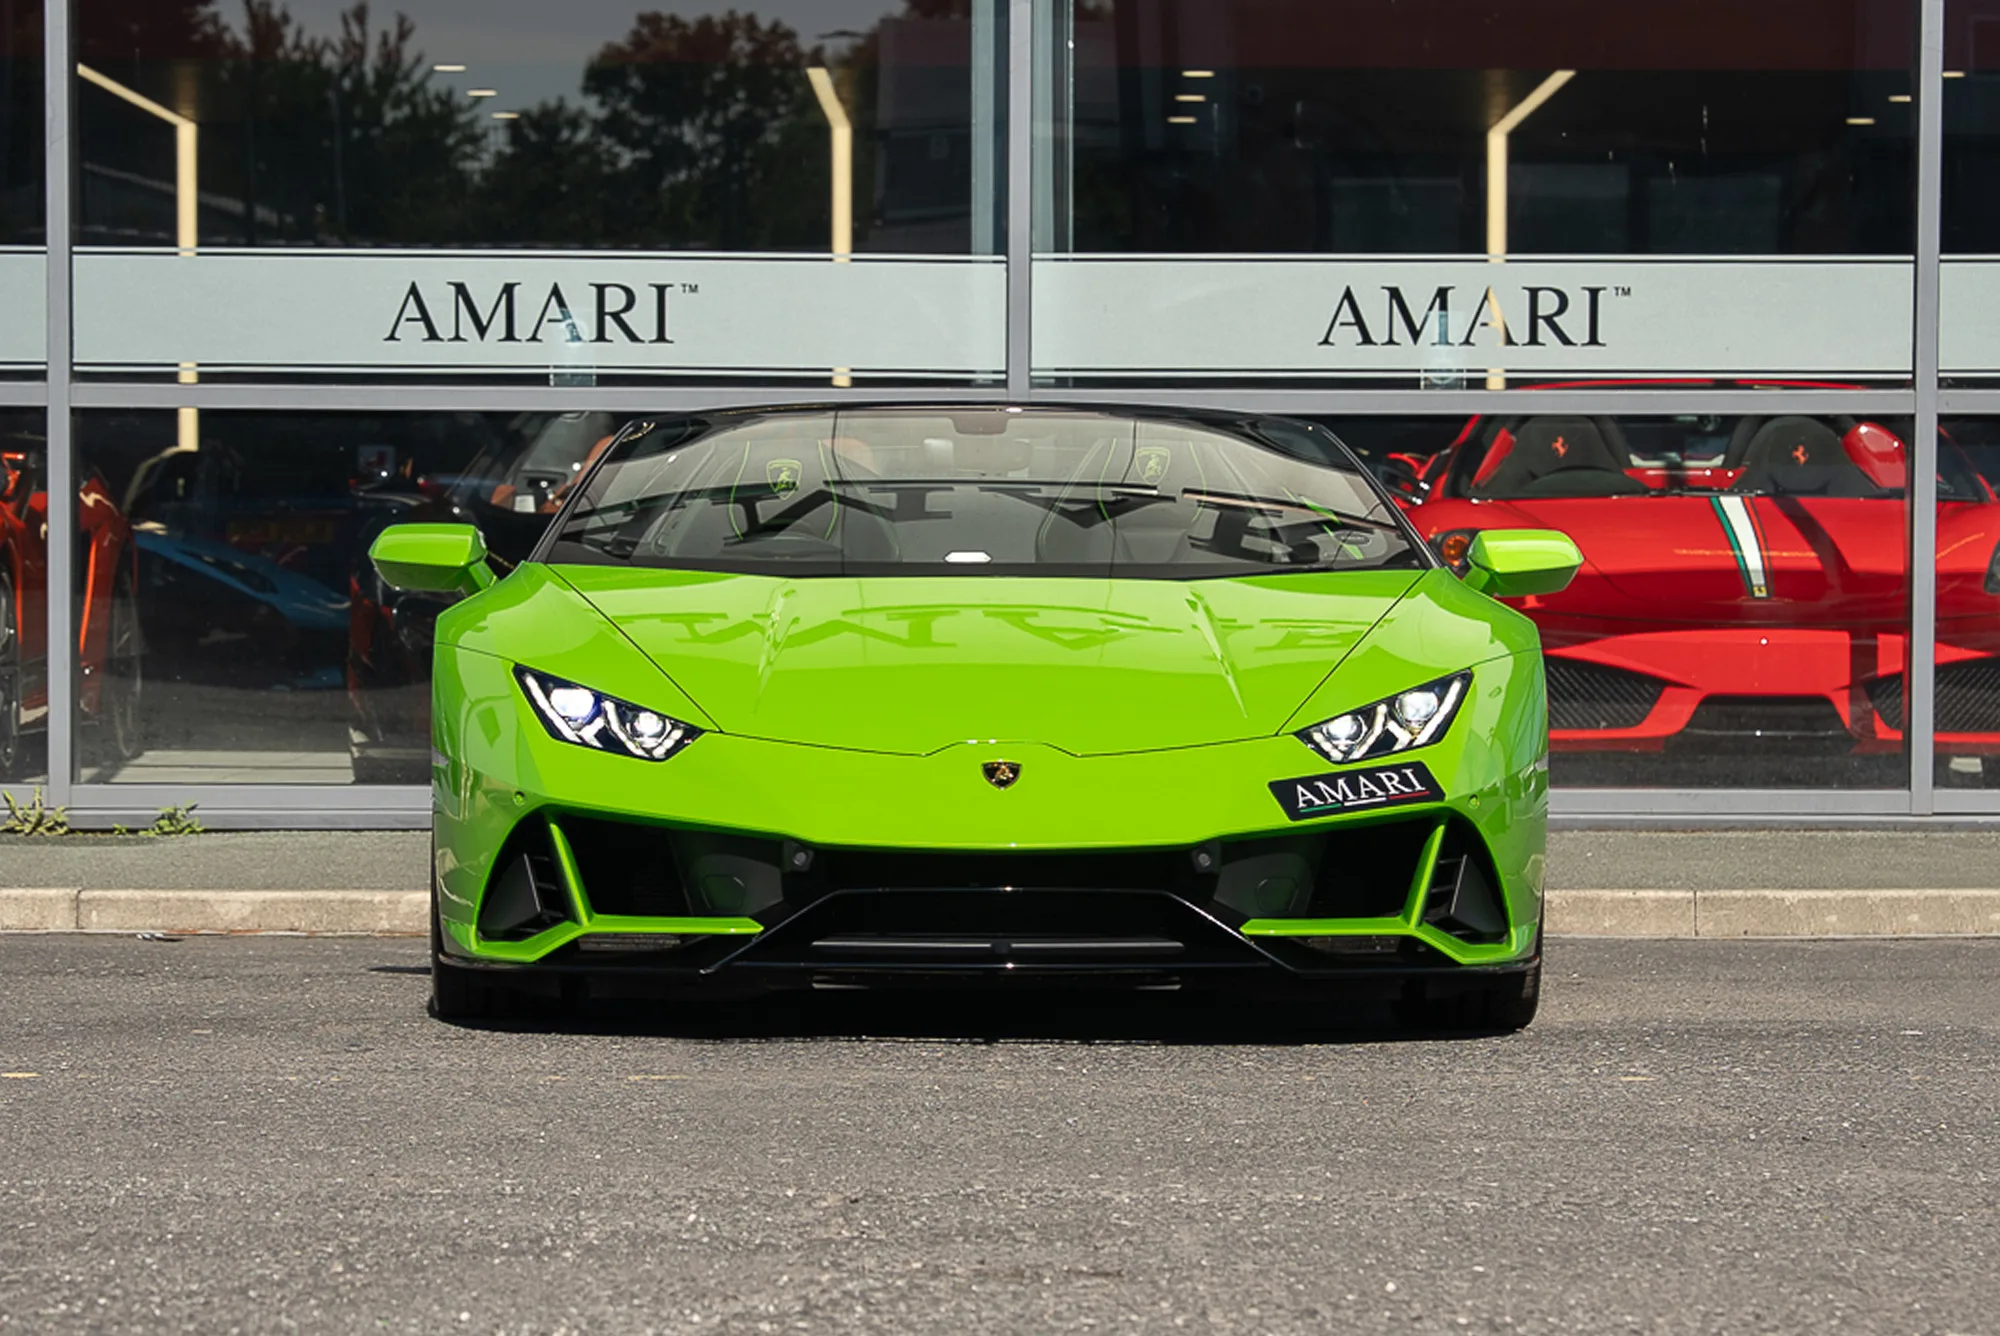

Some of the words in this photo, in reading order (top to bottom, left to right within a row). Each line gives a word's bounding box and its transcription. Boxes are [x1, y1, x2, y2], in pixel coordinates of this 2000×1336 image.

[383, 280, 674, 344] AMARI
[1318, 285, 1607, 346] AMARI
[1296, 768, 1426, 808] AMARI
